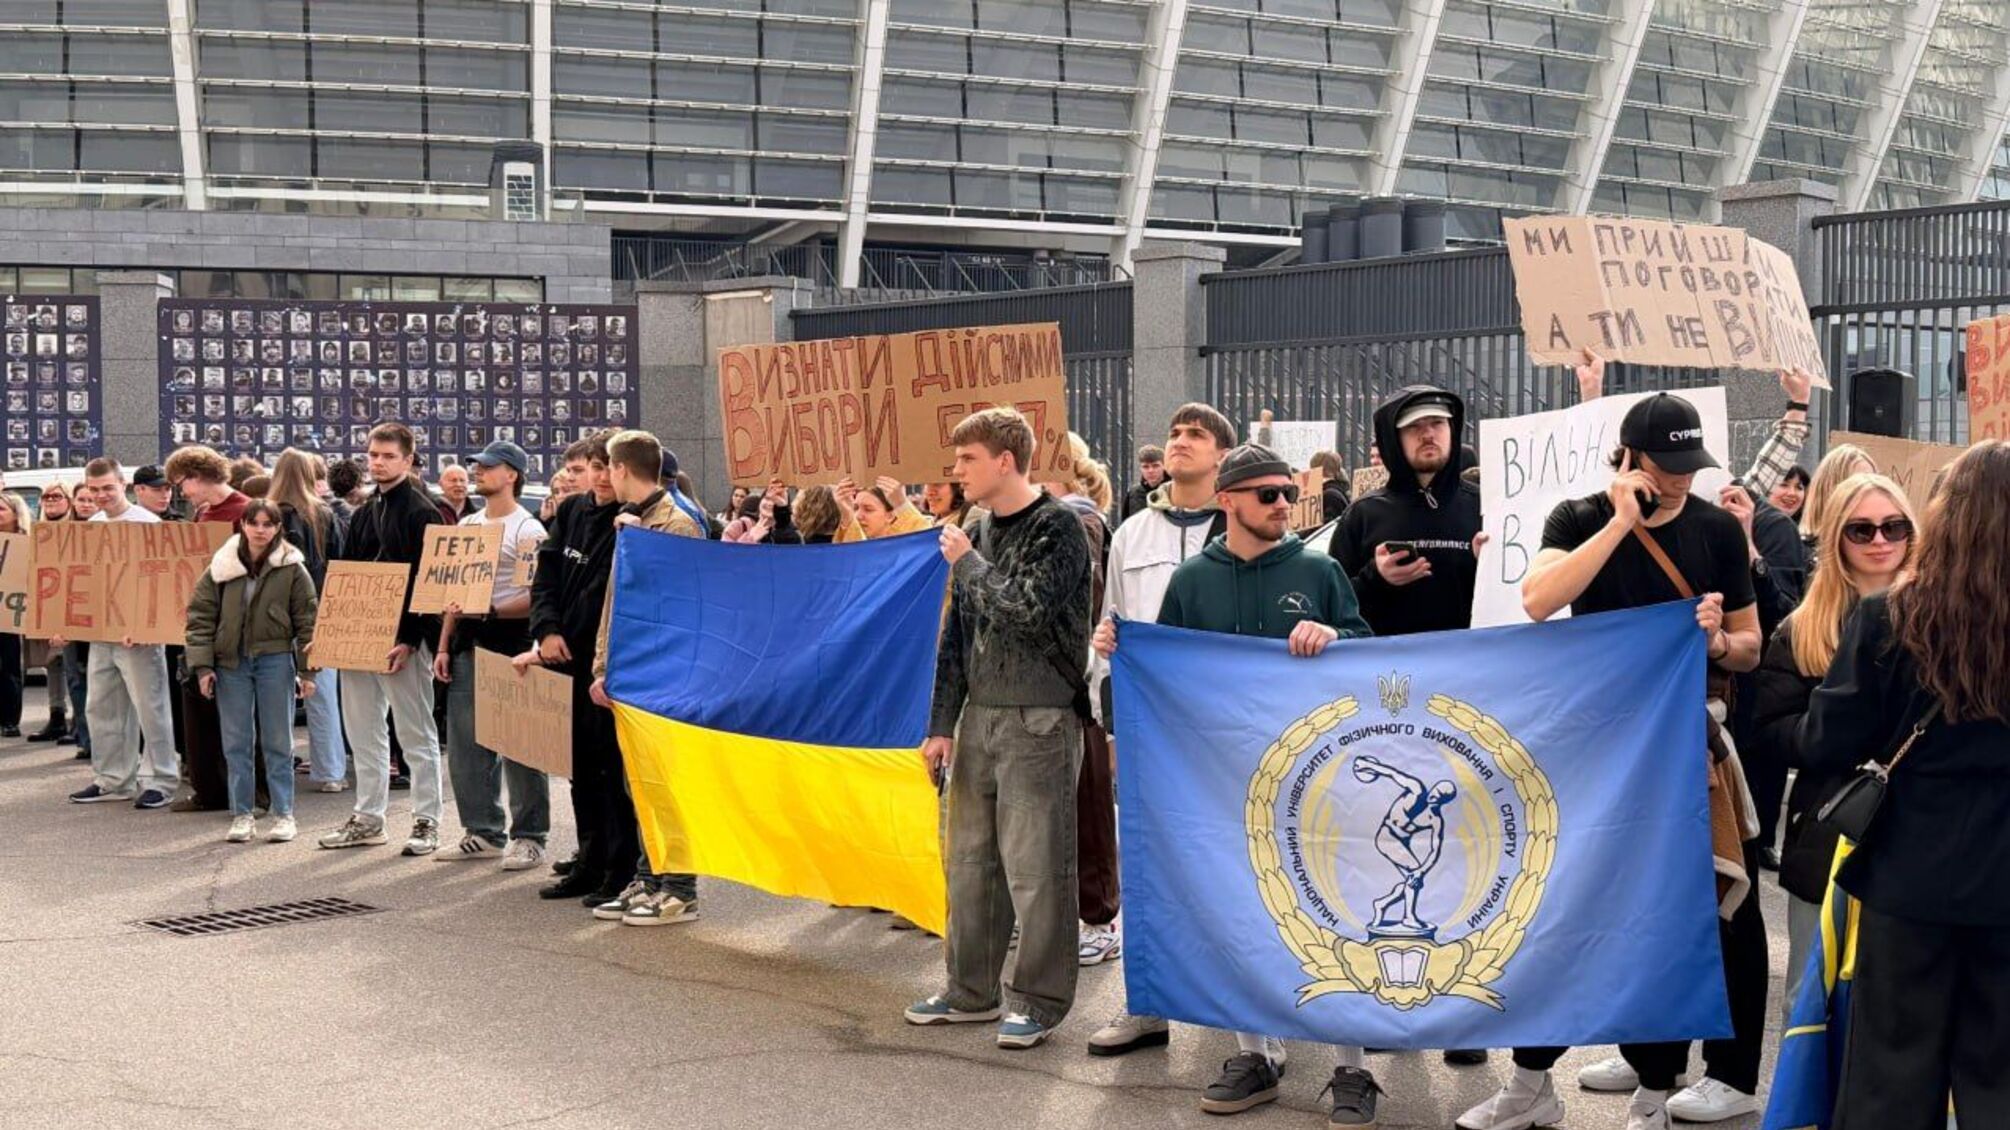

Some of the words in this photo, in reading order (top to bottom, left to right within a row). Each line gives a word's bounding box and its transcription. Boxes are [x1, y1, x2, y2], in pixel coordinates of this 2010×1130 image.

[1522, 226, 1573, 256] МИ
[1549, 313, 1572, 349] А
[1588, 307, 1647, 350] ТИ
[1665, 314, 1711, 349] НЕ
[1502, 420, 1614, 498] ВІЛЬН
[33, 522, 131, 564] РИГАН
[142, 522, 211, 558] НАШ
[434, 536, 486, 557] ГЕТЬ
[1338, 723, 1415, 748] ФІЗИЧНОГО
[1421, 727, 1494, 781] ВИХОВАННЯ
[1287, 744, 1334, 818] УНІВЕРСИТЕТ
[1500, 803, 1517, 858] СПОРТУ
[1287, 826, 1340, 928] НАЦІОНАЛЬНИЙ
[1467, 875, 1509, 929] УКРАЇНИ
